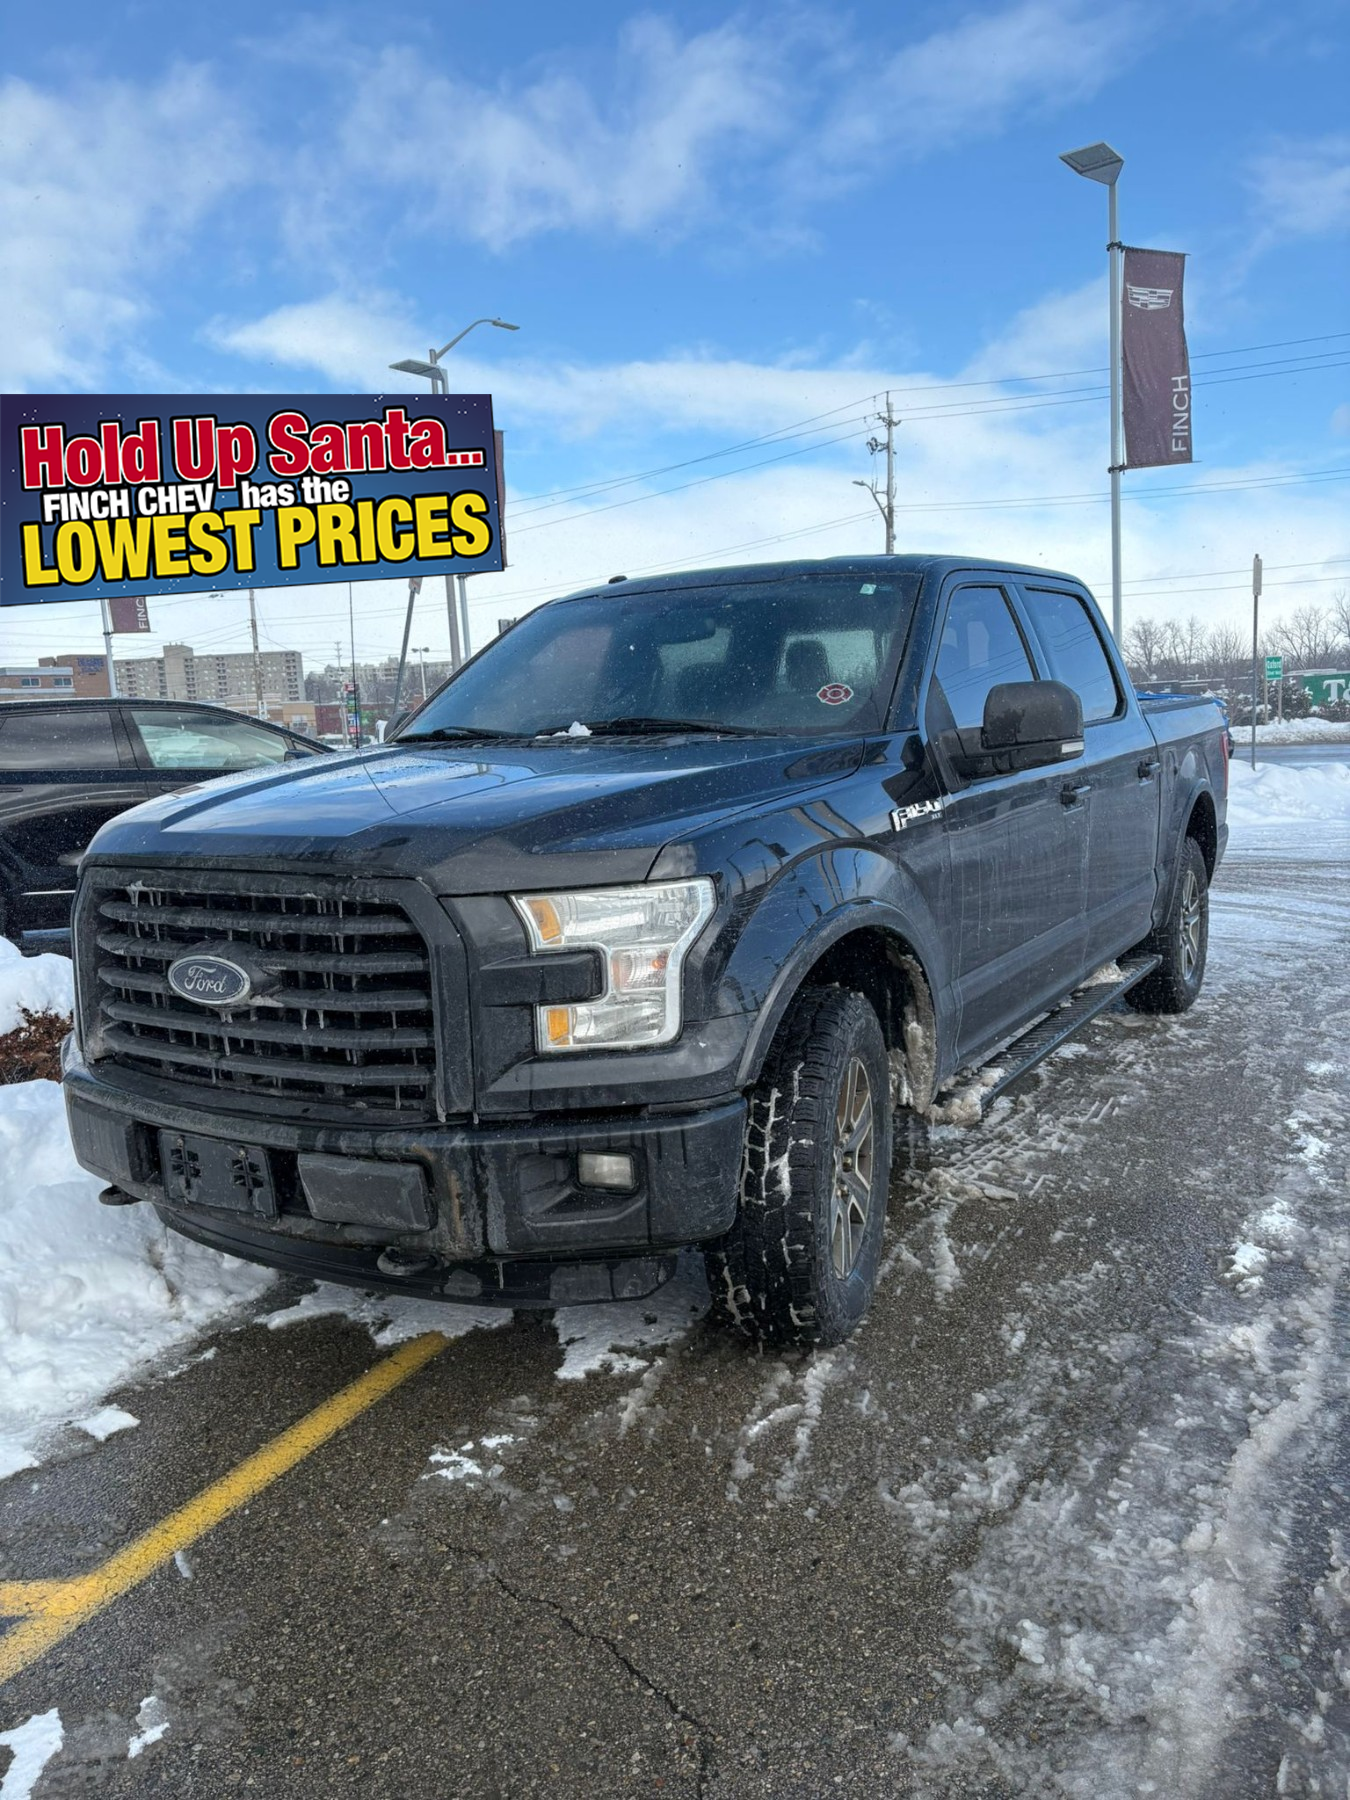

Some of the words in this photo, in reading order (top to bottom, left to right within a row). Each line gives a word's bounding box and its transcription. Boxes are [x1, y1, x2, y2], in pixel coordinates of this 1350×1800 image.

[1171, 375, 1189, 452] FINCH
[135, 596, 149, 629] FINC
[184, 965, 227, 993] Ford
